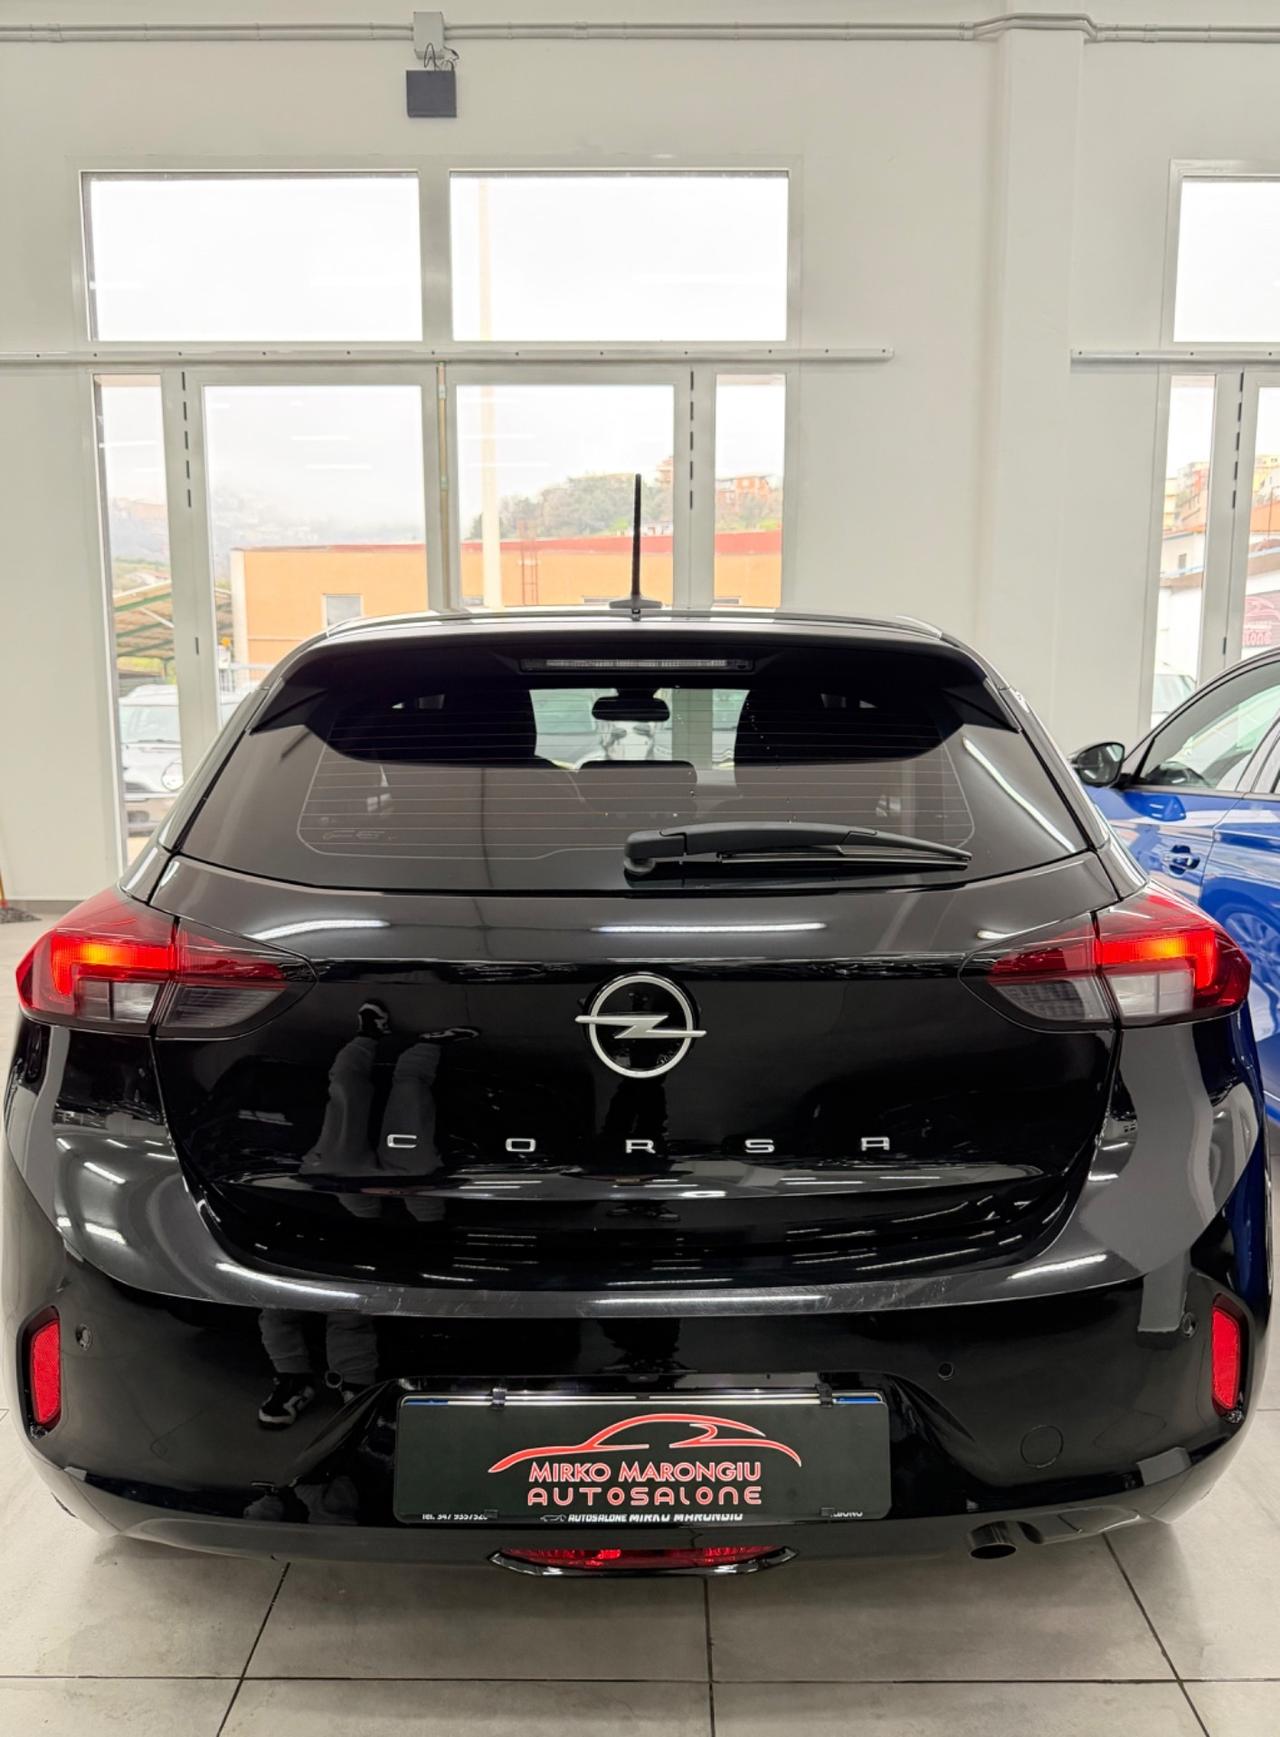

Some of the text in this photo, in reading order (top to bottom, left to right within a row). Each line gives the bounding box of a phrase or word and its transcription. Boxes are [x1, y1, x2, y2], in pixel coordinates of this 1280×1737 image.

[387, 1133, 890, 1154] CORSA
[528, 1461, 761, 1482] MIRKO MARONGIU
[527, 1486, 762, 1506] AUTOSALONE
